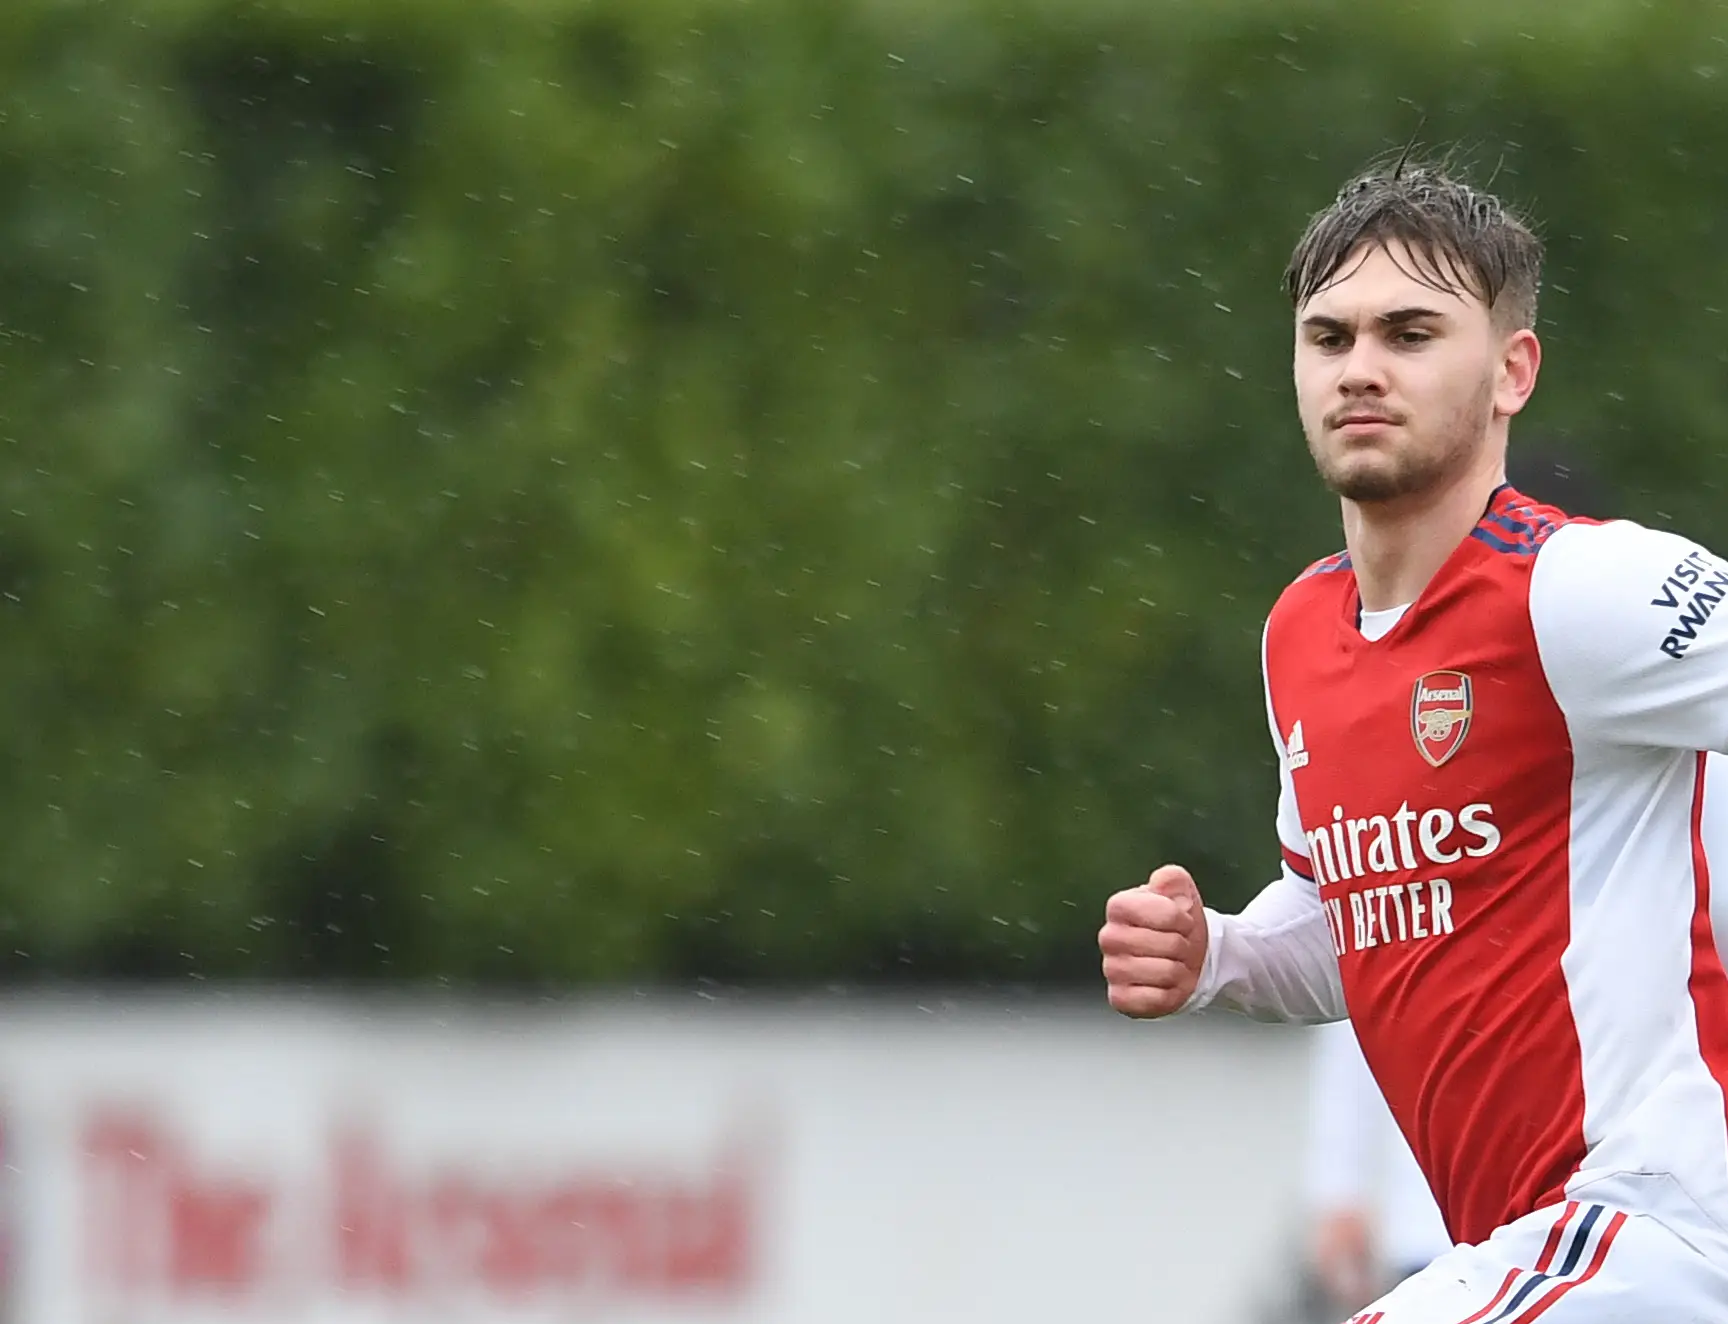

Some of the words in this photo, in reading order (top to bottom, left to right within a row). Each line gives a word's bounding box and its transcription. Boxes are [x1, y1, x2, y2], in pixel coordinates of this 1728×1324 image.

[1420, 686, 1464, 702] Arsenal
[1306, 800, 1501, 888] mirates
[1349, 878, 1454, 951] BETTER
